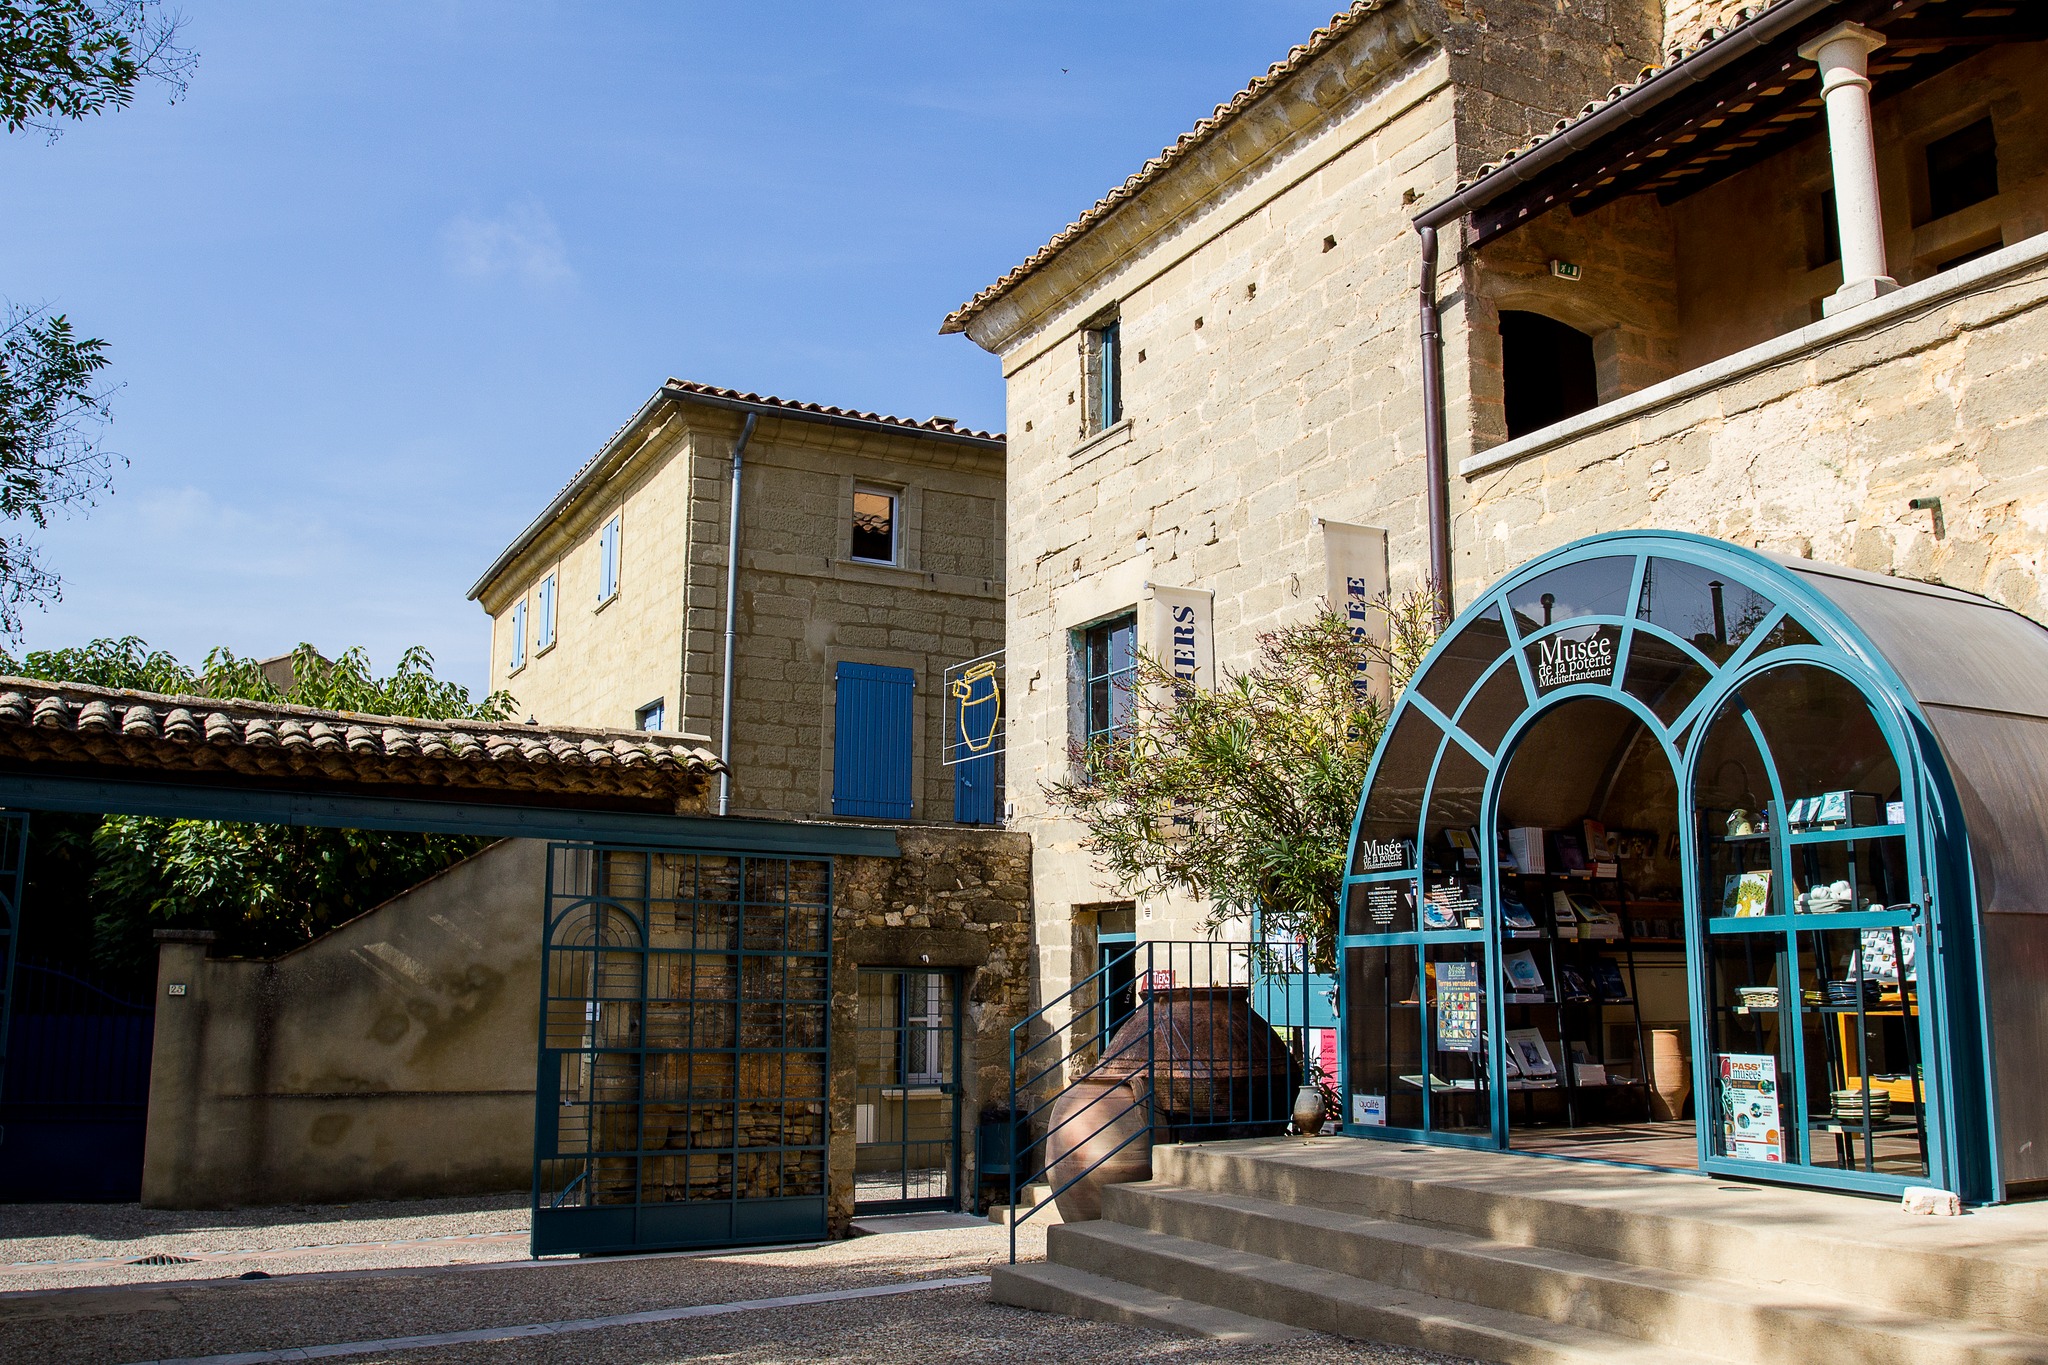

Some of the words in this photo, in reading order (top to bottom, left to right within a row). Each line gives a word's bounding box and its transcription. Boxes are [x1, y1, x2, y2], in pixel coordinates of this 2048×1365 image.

[1538, 632, 1611, 667] Musée
[1538, 662, 1552, 677] de
[1555, 660, 1567, 674] la
[1569, 655, 1611, 676] poterie
[1539, 668, 1611, 688] Méditerranéenne
[1363, 838, 1402, 857] Musée
[171, 985, 183, 993] 25
[1732, 1062, 1760, 1071] PASS'
